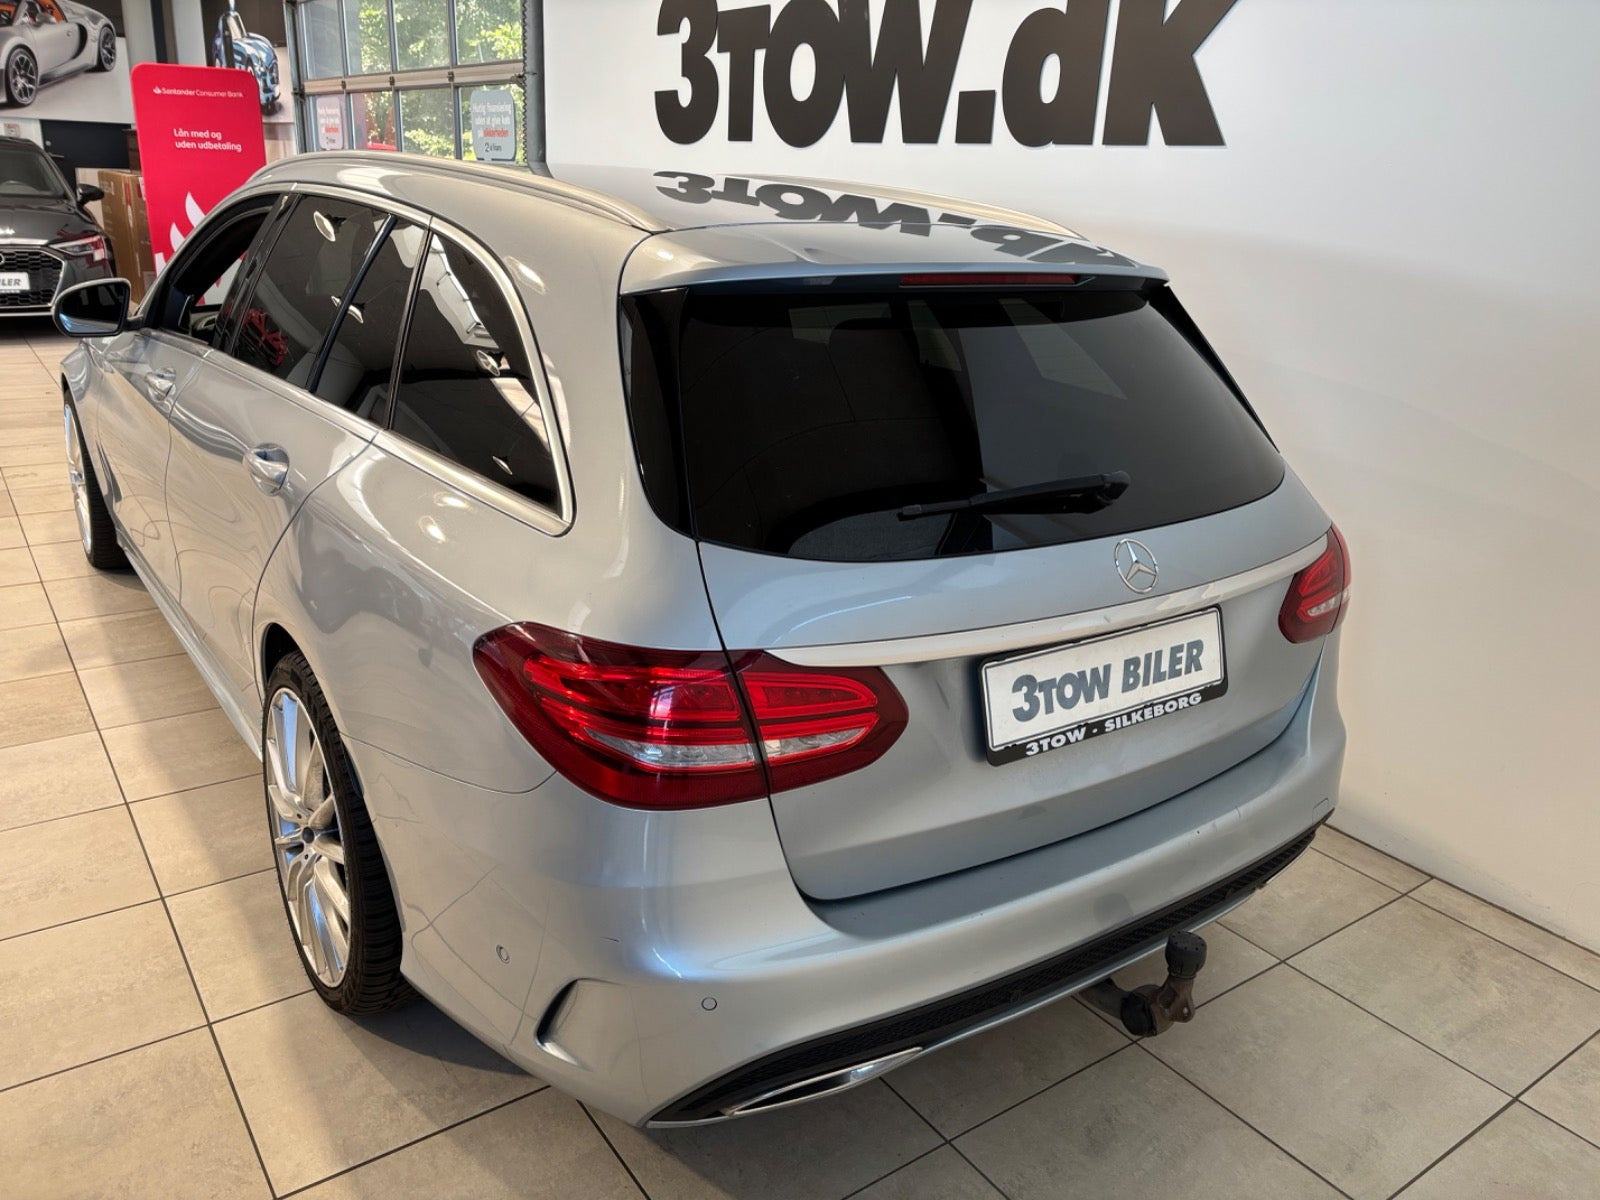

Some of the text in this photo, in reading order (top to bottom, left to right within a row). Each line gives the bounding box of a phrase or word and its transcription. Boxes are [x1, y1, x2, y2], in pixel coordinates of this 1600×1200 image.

[161, 87, 243, 98] Santander Consumer Bank
[173, 128, 222, 141] Lån med og
[175, 140, 242, 153] uden udbetaling
[0, 278, 21, 287] LER
[1011, 638, 1205, 723] 3TOW BILER
[1025, 692, 1202, 757] 3TOW SILKEBORG
